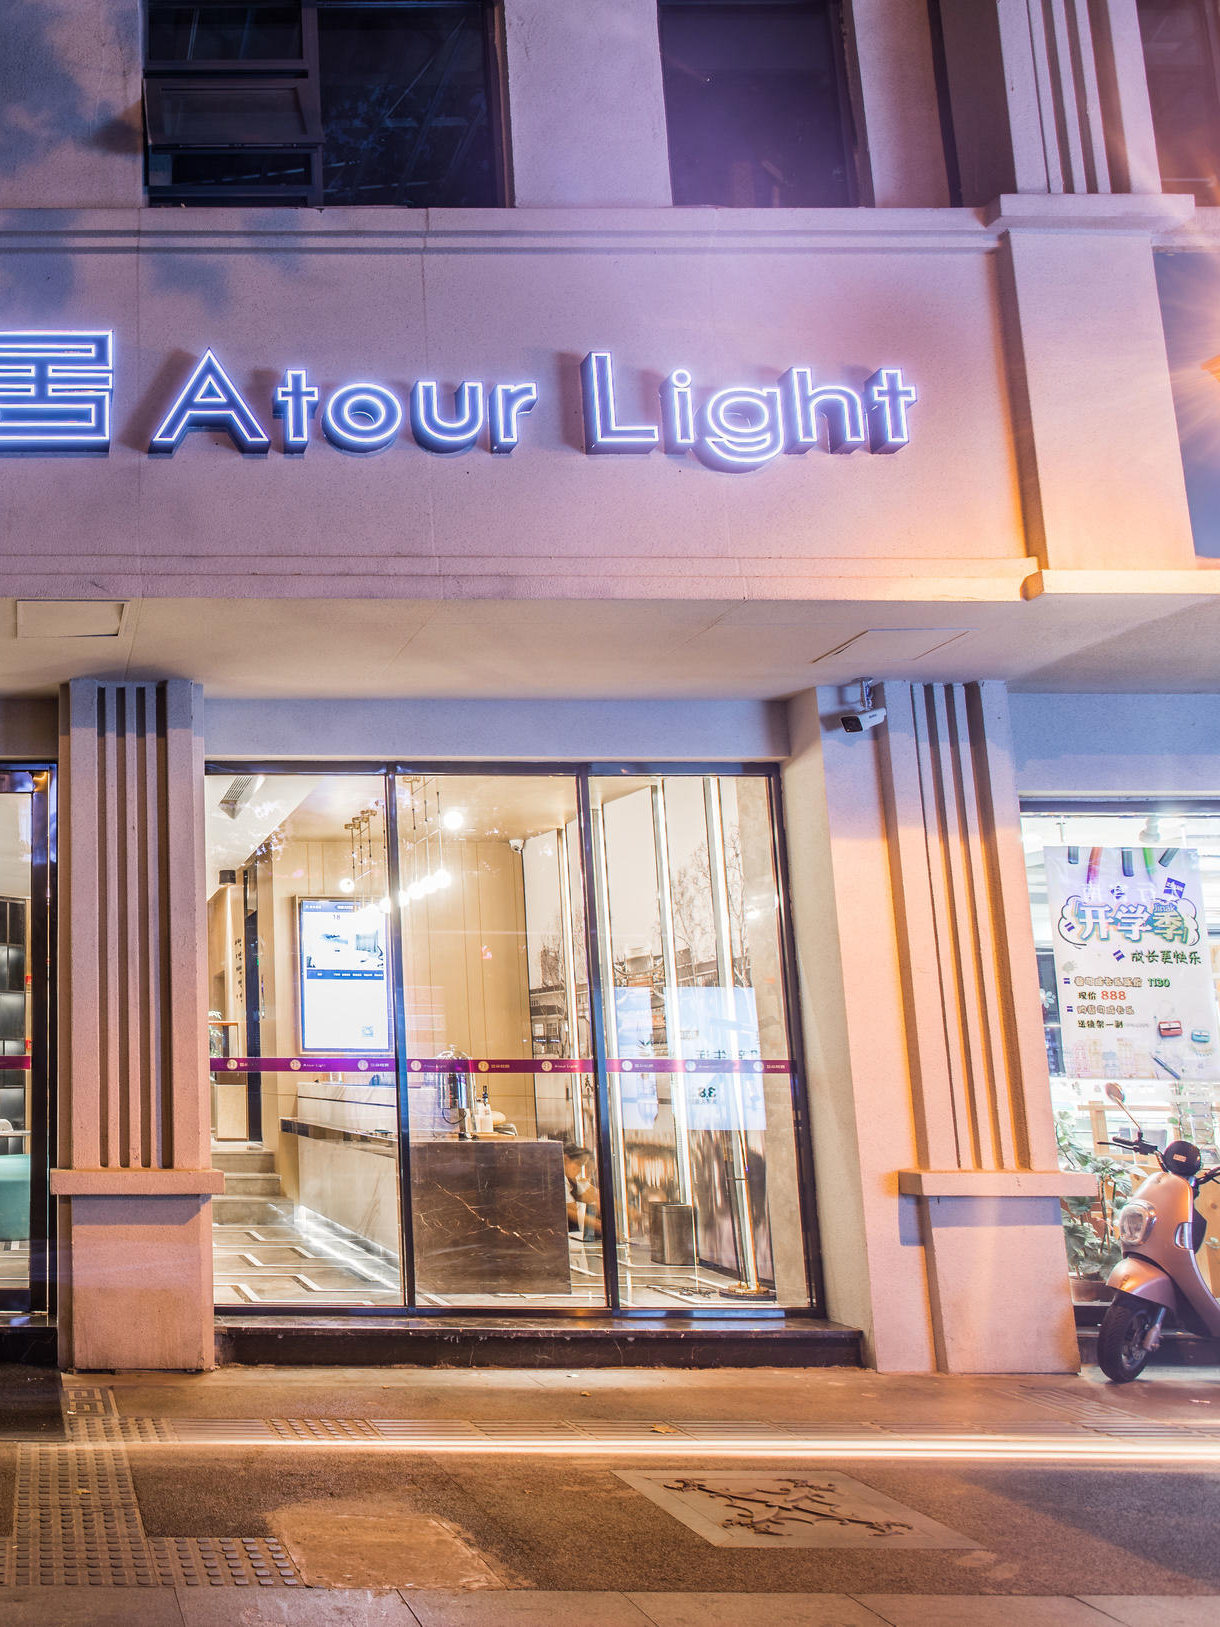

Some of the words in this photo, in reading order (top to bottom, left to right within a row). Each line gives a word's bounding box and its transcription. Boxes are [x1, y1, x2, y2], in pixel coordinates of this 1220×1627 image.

[149, 346, 538, 455] Atour
[581, 350, 918, 472] Light
[1131, 950, 1202, 965] 成长更快乐
[1101, 990, 1126, 1000] 888
